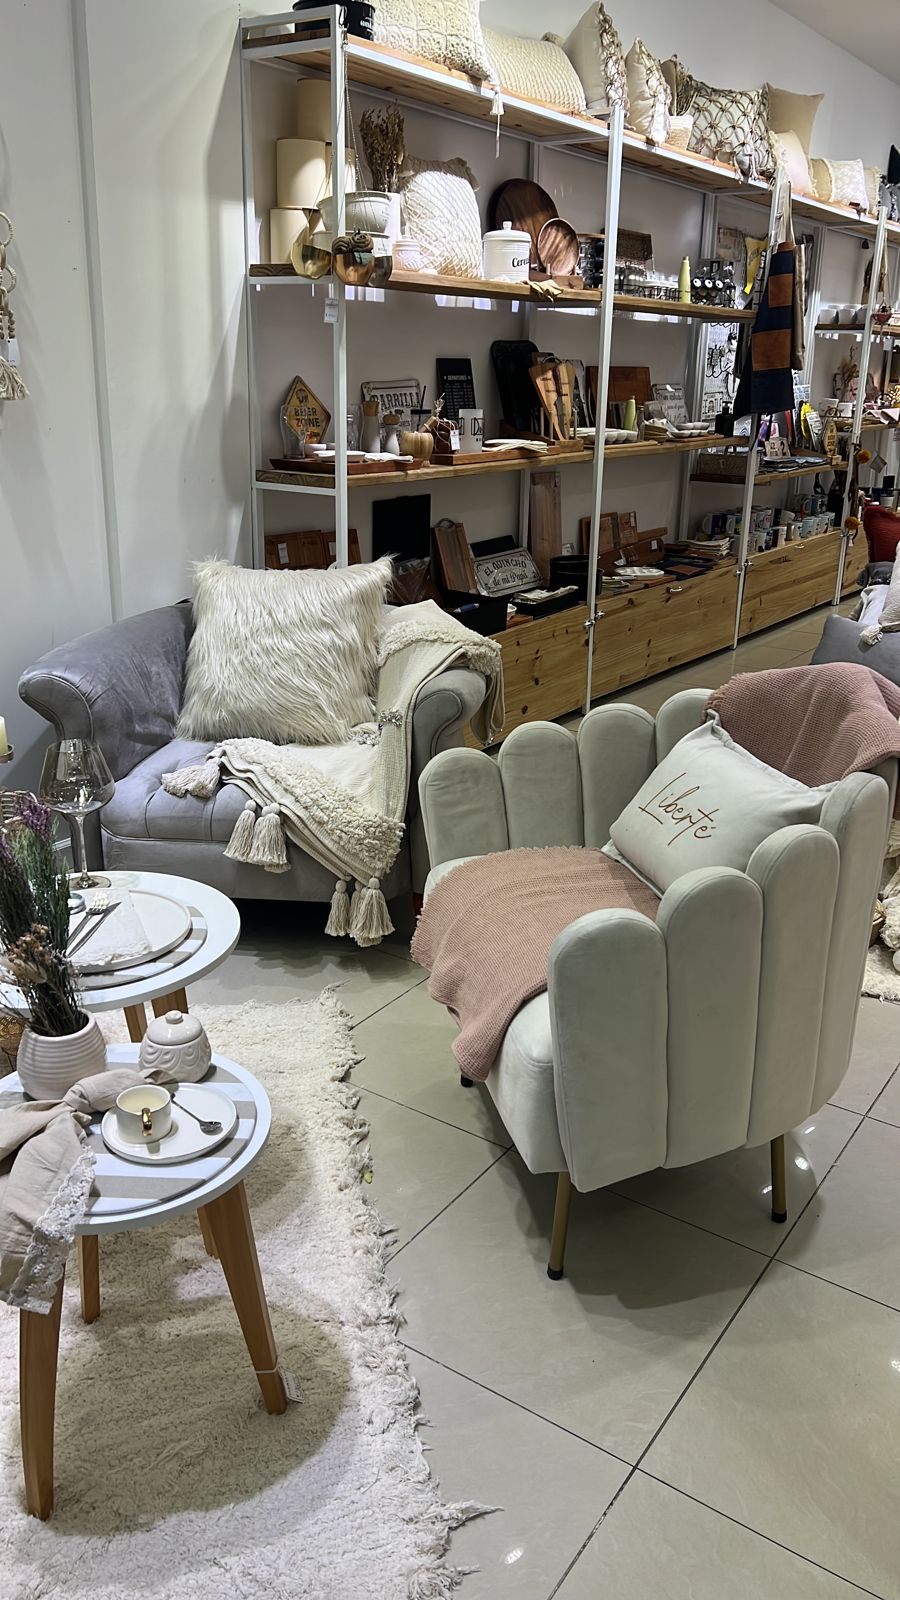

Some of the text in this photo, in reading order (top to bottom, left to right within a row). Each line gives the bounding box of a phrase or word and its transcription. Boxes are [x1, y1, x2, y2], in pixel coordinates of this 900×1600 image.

[294, 407, 317, 417] BEER
[484, 558, 527, 577] EL QUINCHO
